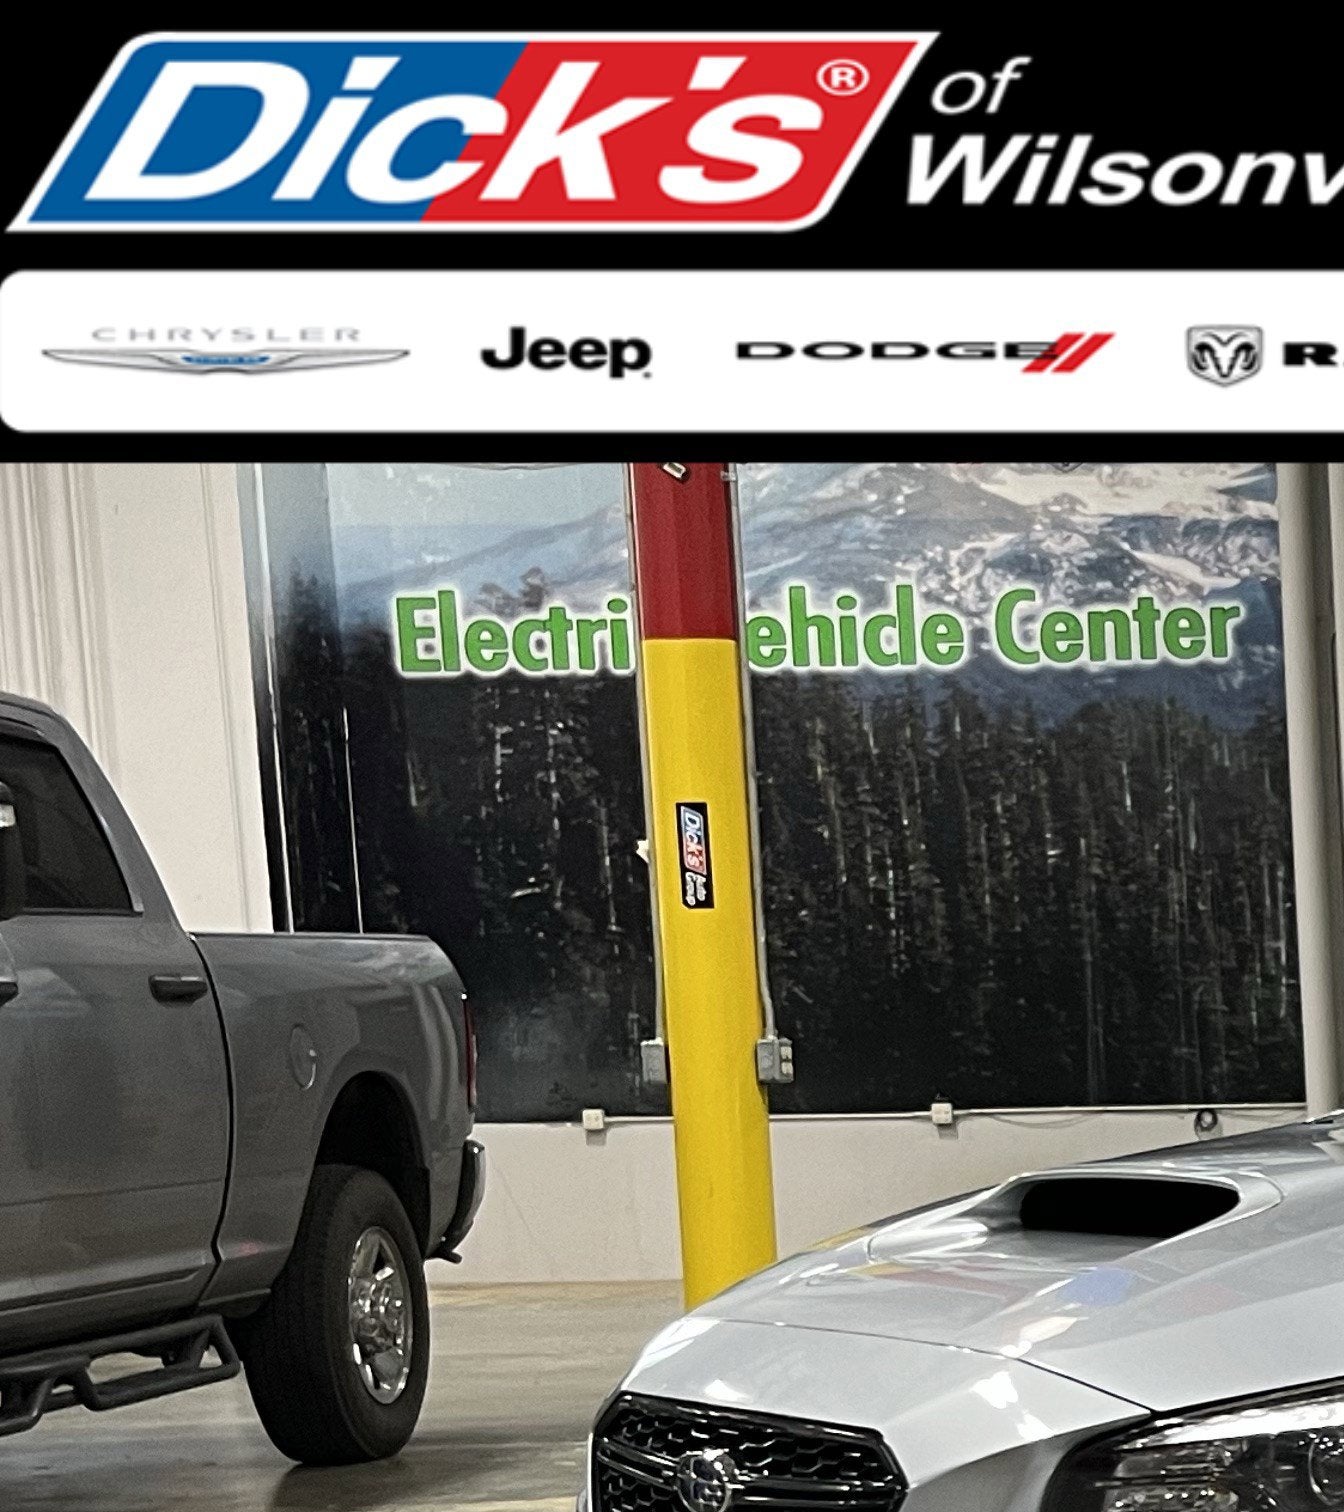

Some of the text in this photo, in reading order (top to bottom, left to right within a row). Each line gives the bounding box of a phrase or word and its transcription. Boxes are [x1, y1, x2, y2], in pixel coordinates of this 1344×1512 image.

[393, 585, 1242, 677] Electri ehicle Center
